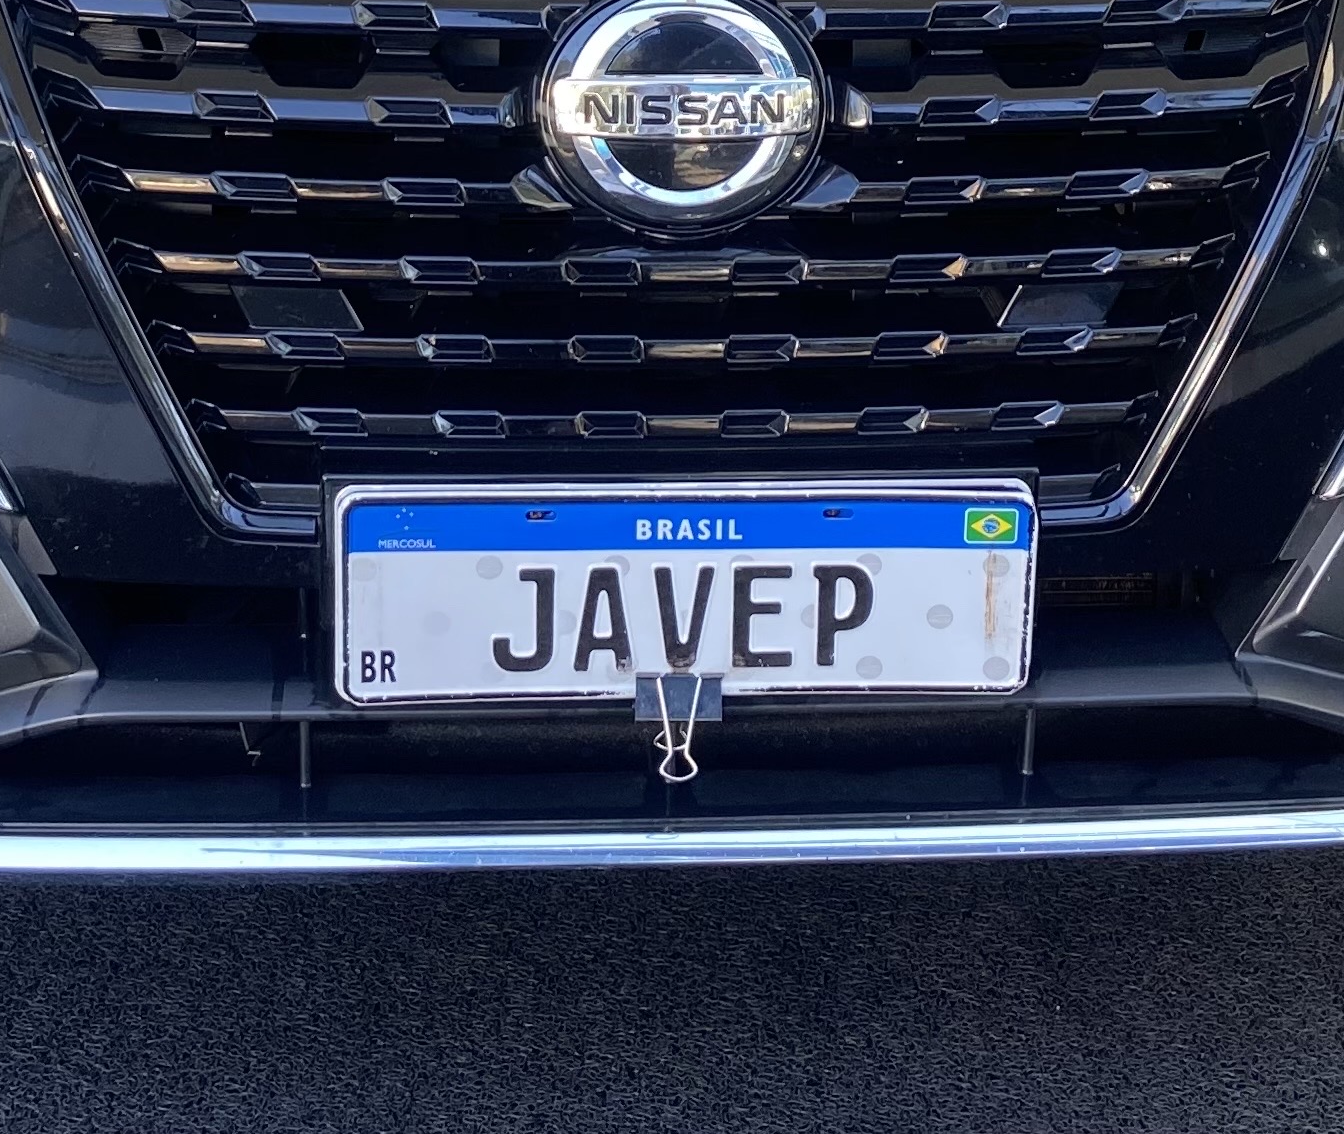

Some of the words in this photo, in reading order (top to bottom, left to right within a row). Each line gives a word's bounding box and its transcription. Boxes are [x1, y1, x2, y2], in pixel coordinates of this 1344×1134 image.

[582, 92, 786, 126] NISSAN
[377, 538, 437, 550] MERCOSUL
[635, 517, 743, 541] BRASIL
[490, 562, 875, 673] JAVEP
[360, 649, 397, 684] BR
